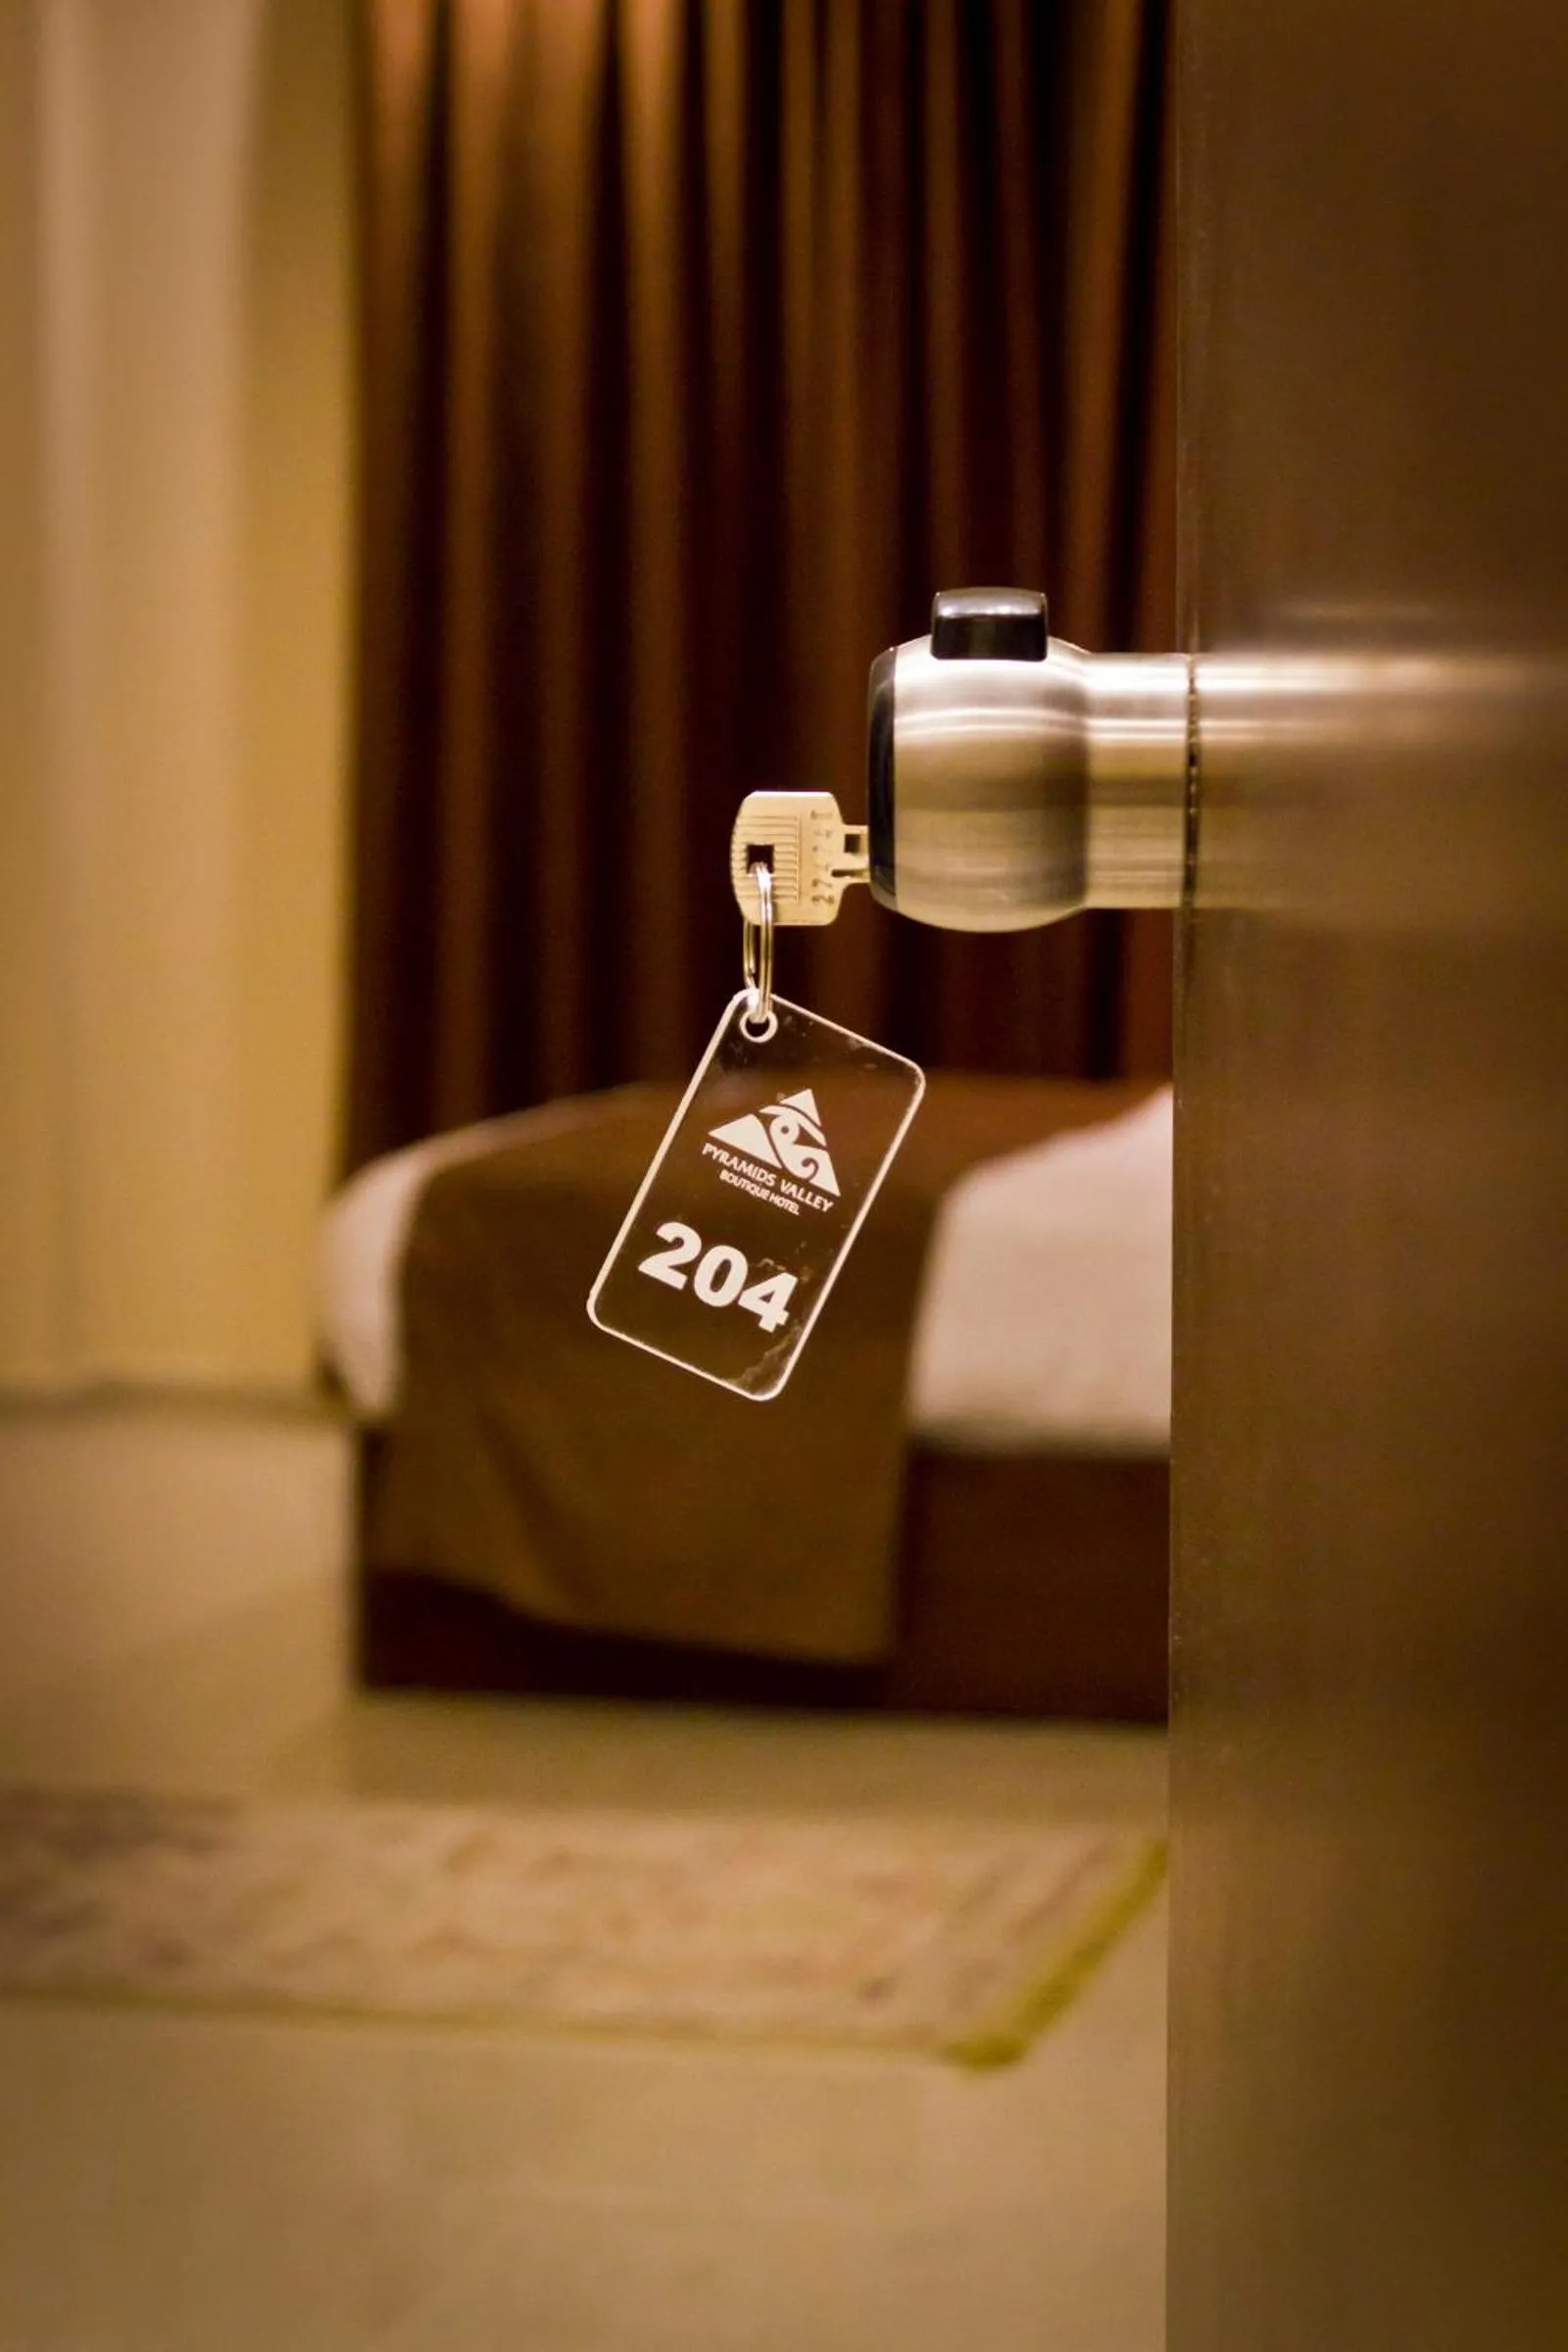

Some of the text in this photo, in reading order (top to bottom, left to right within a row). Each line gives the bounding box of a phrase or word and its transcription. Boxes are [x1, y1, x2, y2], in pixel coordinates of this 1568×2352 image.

[702, 1143, 833, 1212] PYRAMIDS VALLEY
[718, 1169, 801, 1215] BOUTIQUE HOTEL
[638, 1222, 798, 1333] 204
